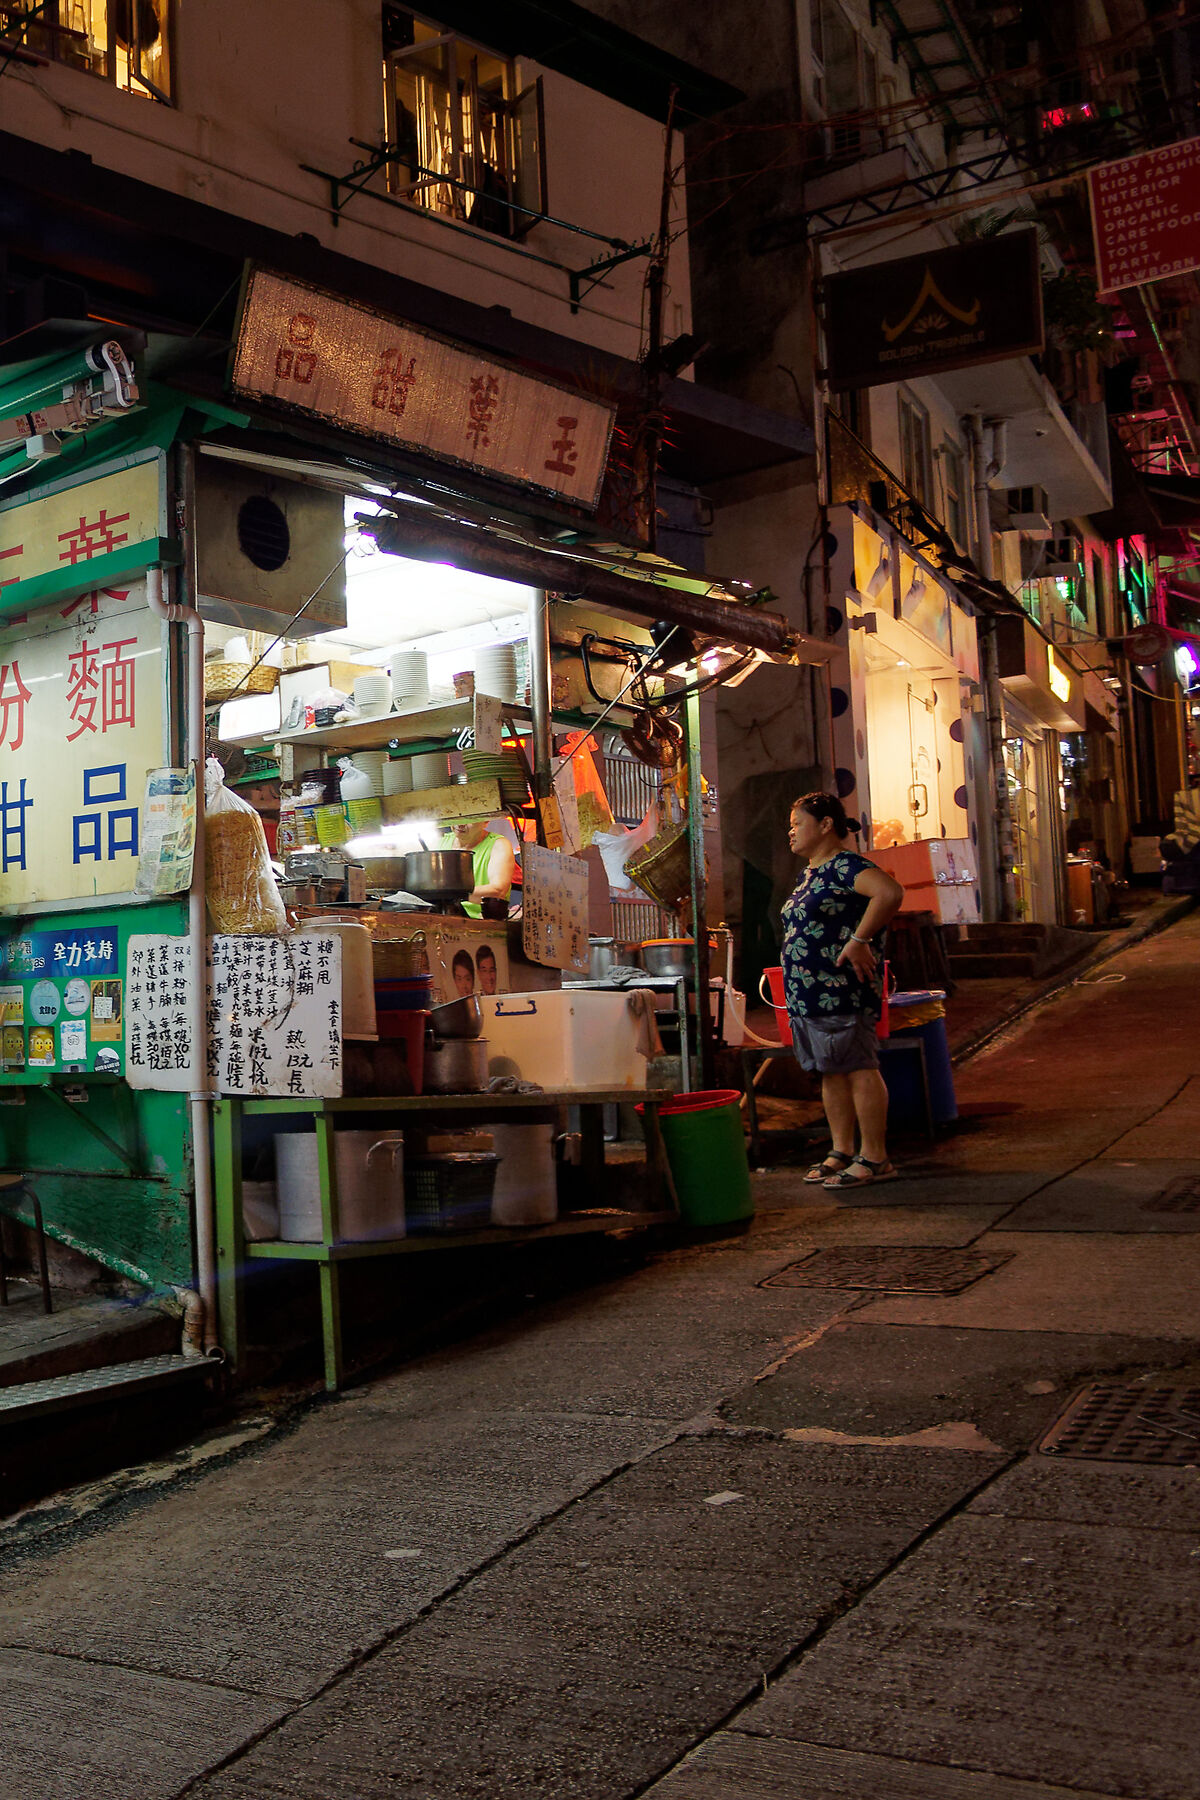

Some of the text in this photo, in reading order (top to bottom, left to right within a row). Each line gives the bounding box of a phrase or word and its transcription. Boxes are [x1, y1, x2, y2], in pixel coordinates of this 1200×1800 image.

[1098, 159, 1140, 179] BABY
[1099, 173, 1138, 192] KIDS
[1101, 174, 1181, 206] INTERIOR
[1102, 194, 1164, 220] TRAVEL
[1103, 203, 1180, 233] ORGANIC
[1107, 240, 1149, 260] TOYS
[1108, 251, 1161, 274] PARTY
[1110, 256, 1195, 287] NEWBORN
[53, 940, 114, 968] 全力支持
[296, 940, 314, 996] 芝麻糊
[317, 938, 334, 985] 糖不甩
